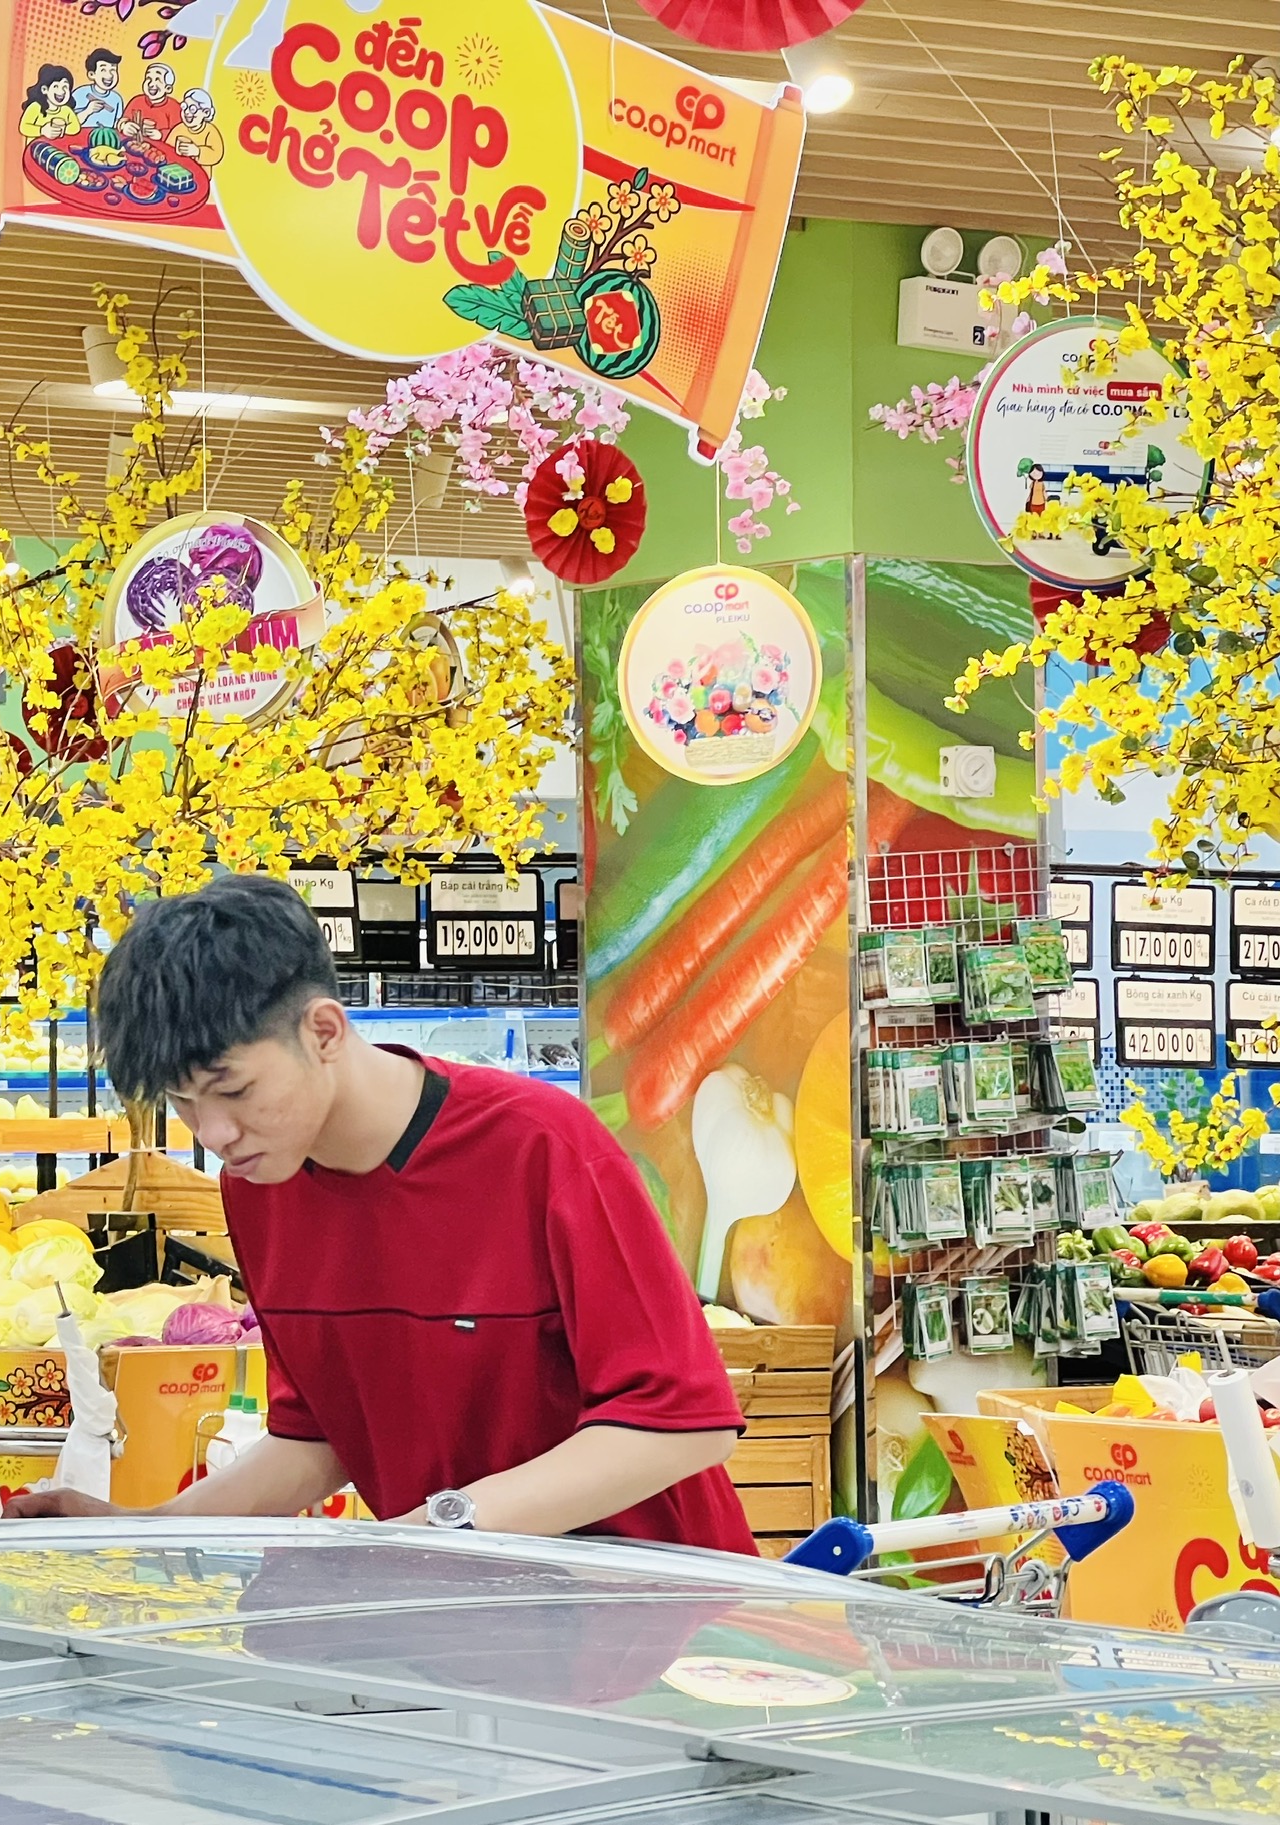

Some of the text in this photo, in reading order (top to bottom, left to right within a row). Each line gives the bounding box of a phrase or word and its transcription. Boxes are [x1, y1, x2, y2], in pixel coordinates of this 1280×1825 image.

[355, 17, 444, 87] đến
[271, 22, 508, 195] Co.op
[238, 105, 546, 286] chở Tết về
[594, 299, 630, 349] Tết
[1012, 383, 1033, 393] Nhà
[1037, 384, 1063, 395] mình
[1083, 386, 1104, 396] việc
[1110, 388, 1134, 397] mua
[716, 614, 750, 623] PLEIKU
[320, 878, 334, 890] Kg
[1170, 895, 1182, 906] Kg
[442, 924, 515, 948] 19.000
[1125, 936, 1192, 958] 17.000
[1167, 989, 1188, 1000] xanh
[1190, 989, 1202, 1002] Kg
[1129, 1032, 1194, 1053] 42.000
[159, 1382, 225, 1396] co.opmart
